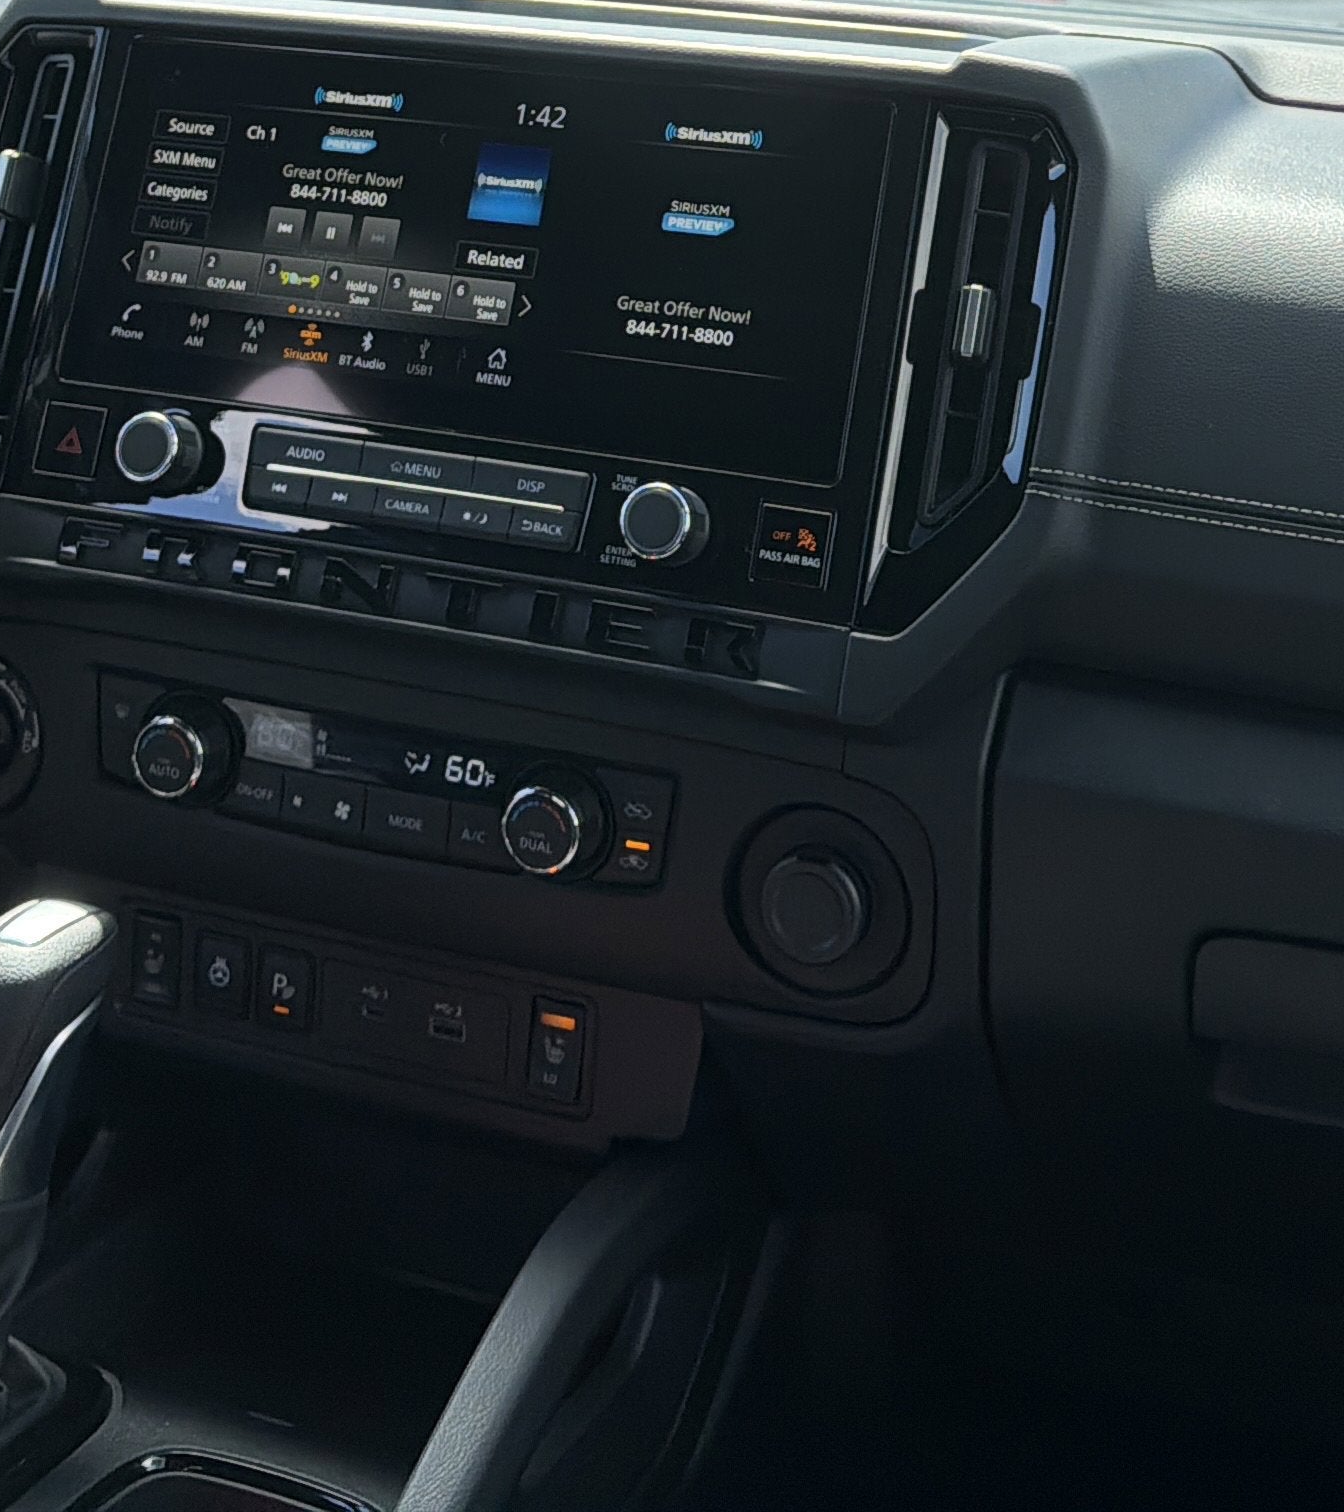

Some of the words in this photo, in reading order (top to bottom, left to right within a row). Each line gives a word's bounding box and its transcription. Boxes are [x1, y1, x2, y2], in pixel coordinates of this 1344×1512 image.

[517, 103, 566, 128] 1:42
[168, 118, 214, 135] Source
[246, 125, 265, 139] Ch
[270, 127, 276, 140] 1
[153, 149, 180, 164] SXM
[181, 152, 215, 168] Menu
[282, 163, 321, 180] Great
[324, 168, 362, 183] Offer
[364, 172, 403, 188] Now!
[147, 181, 207, 201] Categories
[290, 183, 387, 206] 844-711-8800
[670, 200, 729, 217] SIRIUSXM
[148, 215, 192, 235] Notify
[149, 249, 155, 260] 1
[207, 256, 216, 267] 2
[467, 249, 524, 269] Related
[146, 269, 167, 282] 92.9
[170, 272, 187, 283] FM
[268, 263, 276, 275] 3
[330, 270, 339, 282] 4
[206, 276, 226, 289] 620
[226, 279, 246, 290] AM
[345, 280, 367, 292] Hold
[367, 283, 377, 293] to
[392, 277, 401, 289] 5
[456, 285, 464, 297] 6
[348, 292, 369, 305] Save
[617, 295, 659, 313] Great
[663, 300, 705, 318] Offer
[708, 305, 750, 324] Now!
[110, 325, 143, 339] Phone
[626, 319, 733, 345] 844-711-8800
[183, 335, 203, 346] AM
[240, 342, 257, 353] FM
[283, 347, 327, 363] SiriusXM
[338, 354, 352, 365] BT
[353, 356, 385, 370] Audio
[406, 362, 432, 375] USB1
[475, 372, 510, 386] MENU
[286, 445, 326, 462] AUDIO
[405, 462, 442, 478] MENU
[517, 478, 546, 493] DISP
[385, 498, 430, 515] CAMERA
[533, 520, 563, 536] BACK
[772, 530, 792, 542] OFF
[600, 554, 637, 568] SETTING
[759, 549, 782, 561] PASS
[783, 552, 800, 565] AIR
[801, 556, 821, 569] BAG
[59, 515, 766, 679] FRONTIER
[149, 762, 179, 780] AUTO
[387, 813, 423, 831] MODE
[462, 827, 486, 844] A/C
[520, 837, 553, 855] DUAL
